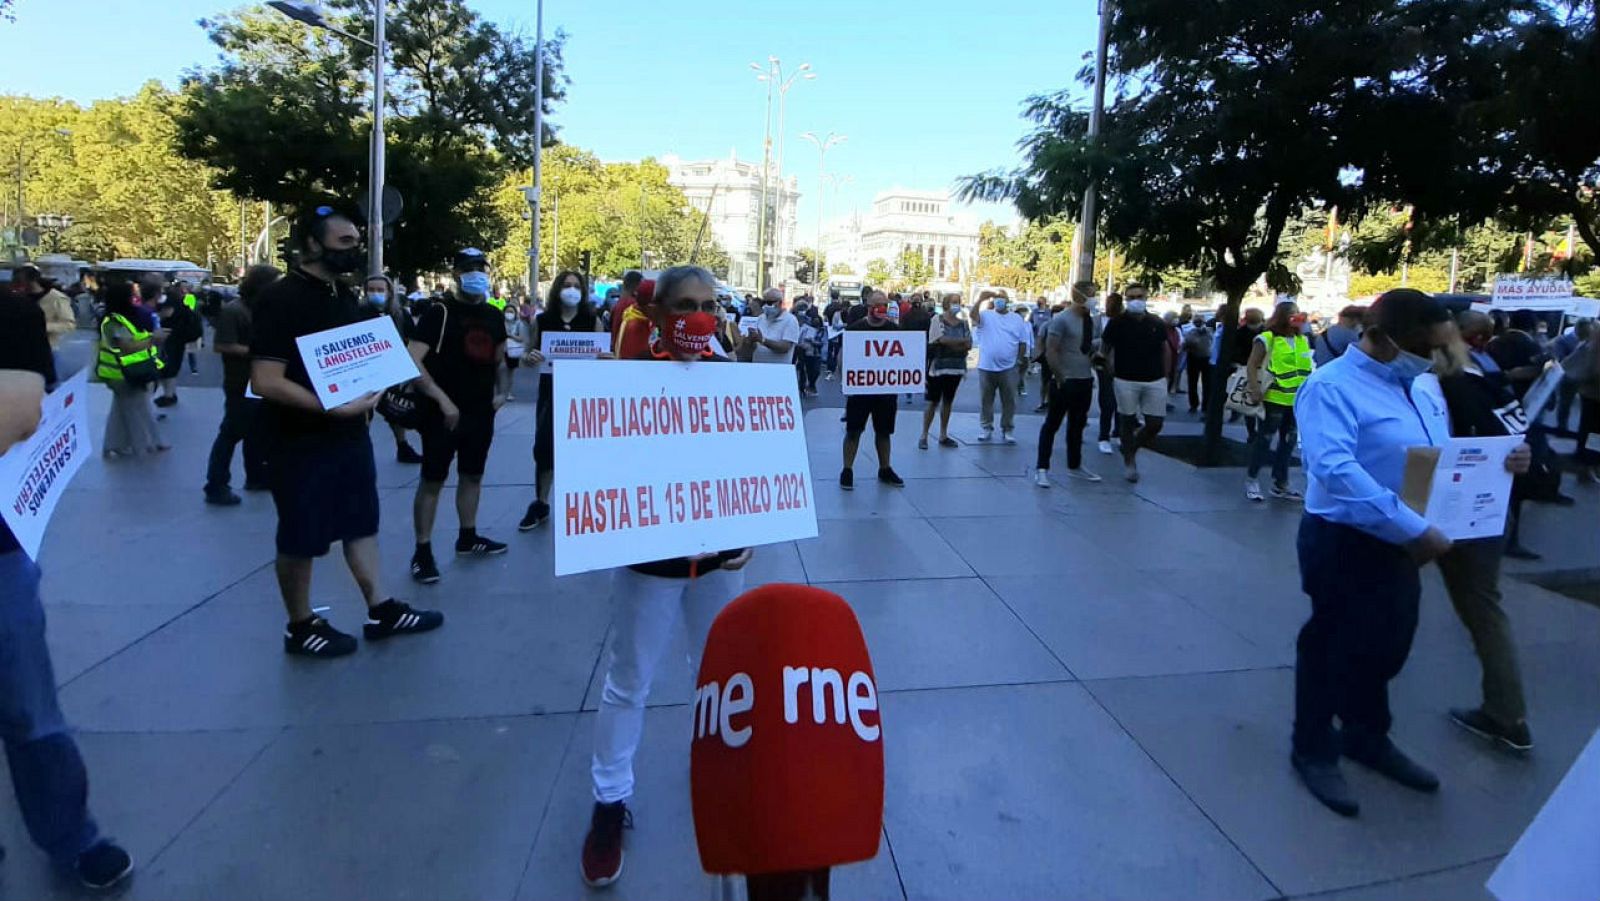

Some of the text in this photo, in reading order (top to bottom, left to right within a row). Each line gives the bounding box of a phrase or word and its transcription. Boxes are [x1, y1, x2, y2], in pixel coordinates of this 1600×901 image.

[314, 332, 376, 358] #SALVEMOS
[865, 340, 904, 357] IVA
[846, 369, 922, 386] REDUCIDO
[567, 387, 795, 439] AMPLIACIÓN DE LOS ERTES
[28, 438, 78, 517] #SALVEMOS
[566, 472, 808, 536] HASTA EL 15 DE MARZO 2021
[783, 665, 880, 741] rne
